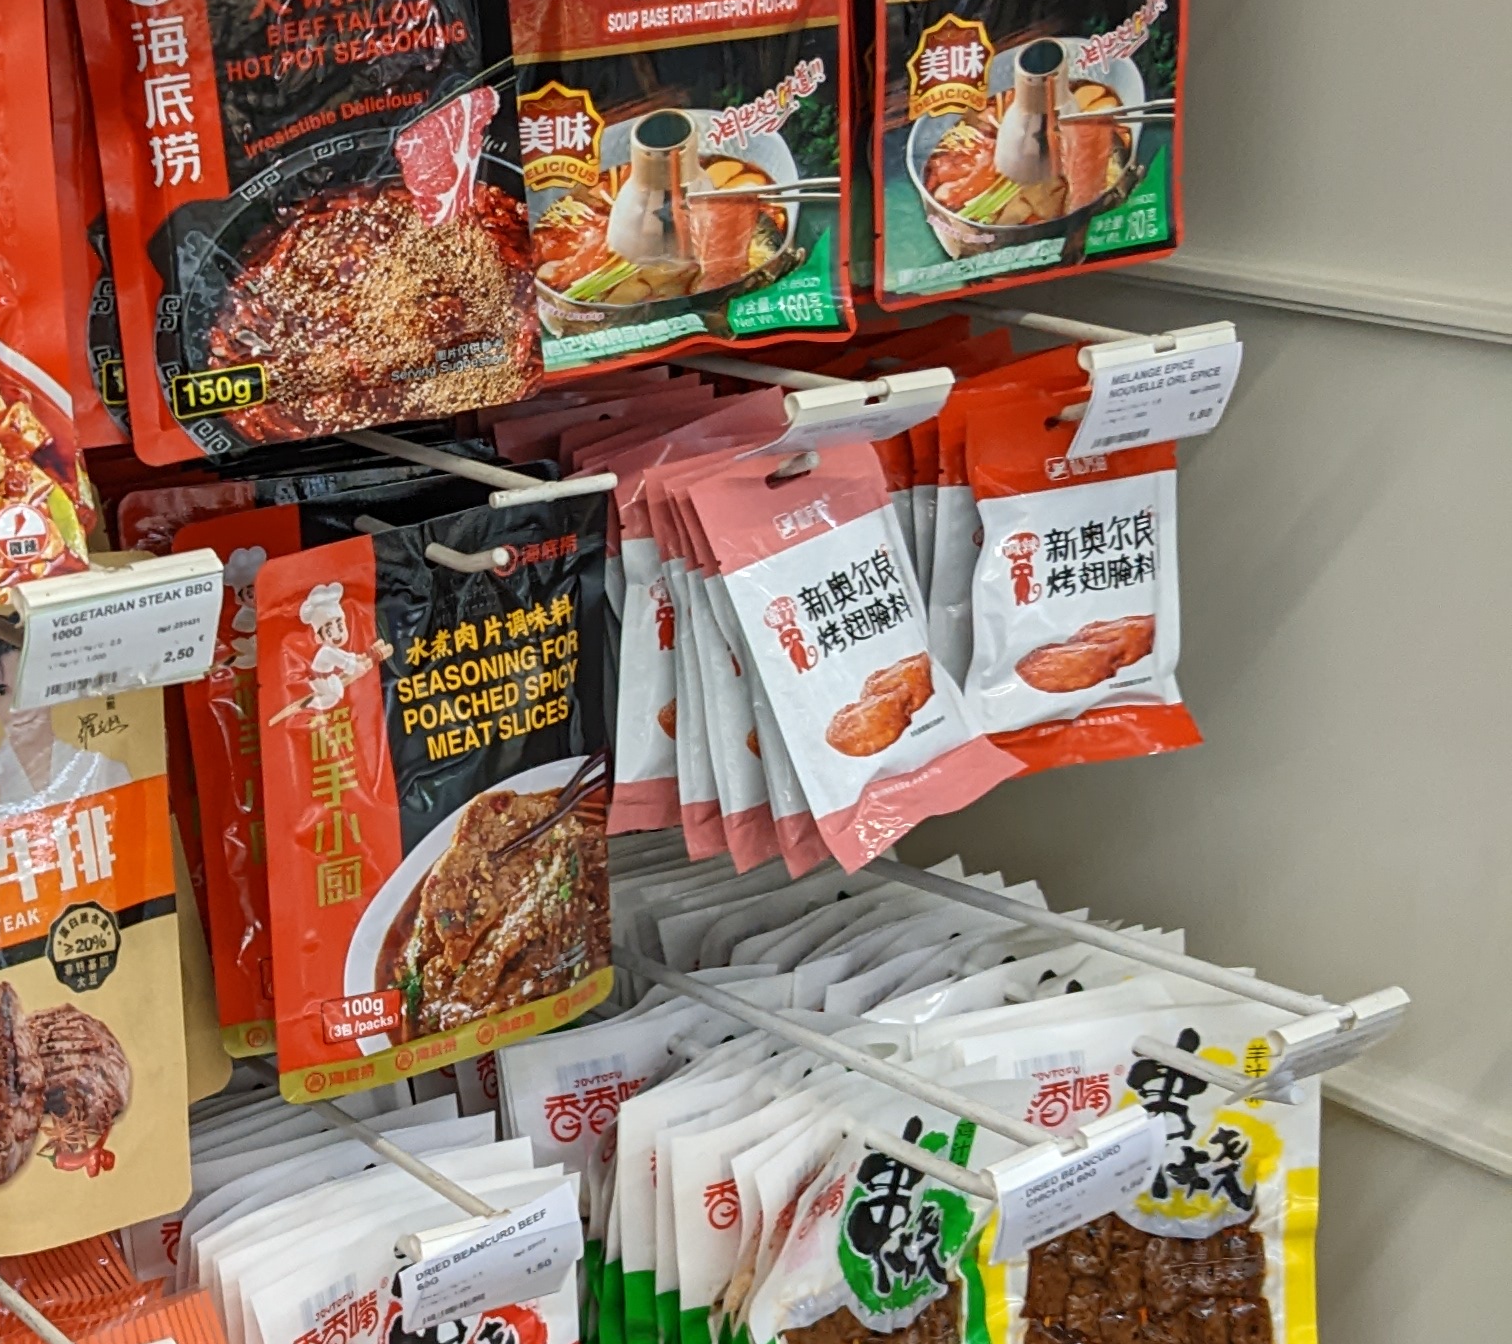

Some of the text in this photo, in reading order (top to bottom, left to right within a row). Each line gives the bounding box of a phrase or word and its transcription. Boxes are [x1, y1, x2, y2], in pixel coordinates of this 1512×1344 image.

[226, 20, 468, 82] HOT POT SEASONING
[918, 42, 985, 84] 美味
[130, 15, 203, 189] 海底捞
[518, 112, 593, 155] 美味
[180, 372, 252, 409] 150g
[1111, 358, 1195, 386] MELANGE EPICE
[1043, 508, 1157, 563] 新奥尔良
[52, 581, 213, 628] VEGETARIAN STEAK BBQ
[796, 546, 901, 623] 新奥尔良
[51, 625, 83, 641] 100G
[163, 646, 195, 664] 2,50
[404, 593, 575, 667] 水煮肉片调味料
[396, 628, 580, 704] SEASONING FOR
[402, 658, 578, 734] POACHED SPICY
[426, 699, 570, 762] MEAT SLICES
[307, 706, 364, 909] 筷手小厨
[340, 996, 385, 1019] 100g
[415, 1208, 548, 1282] DRIED BEANCURD BEEF
